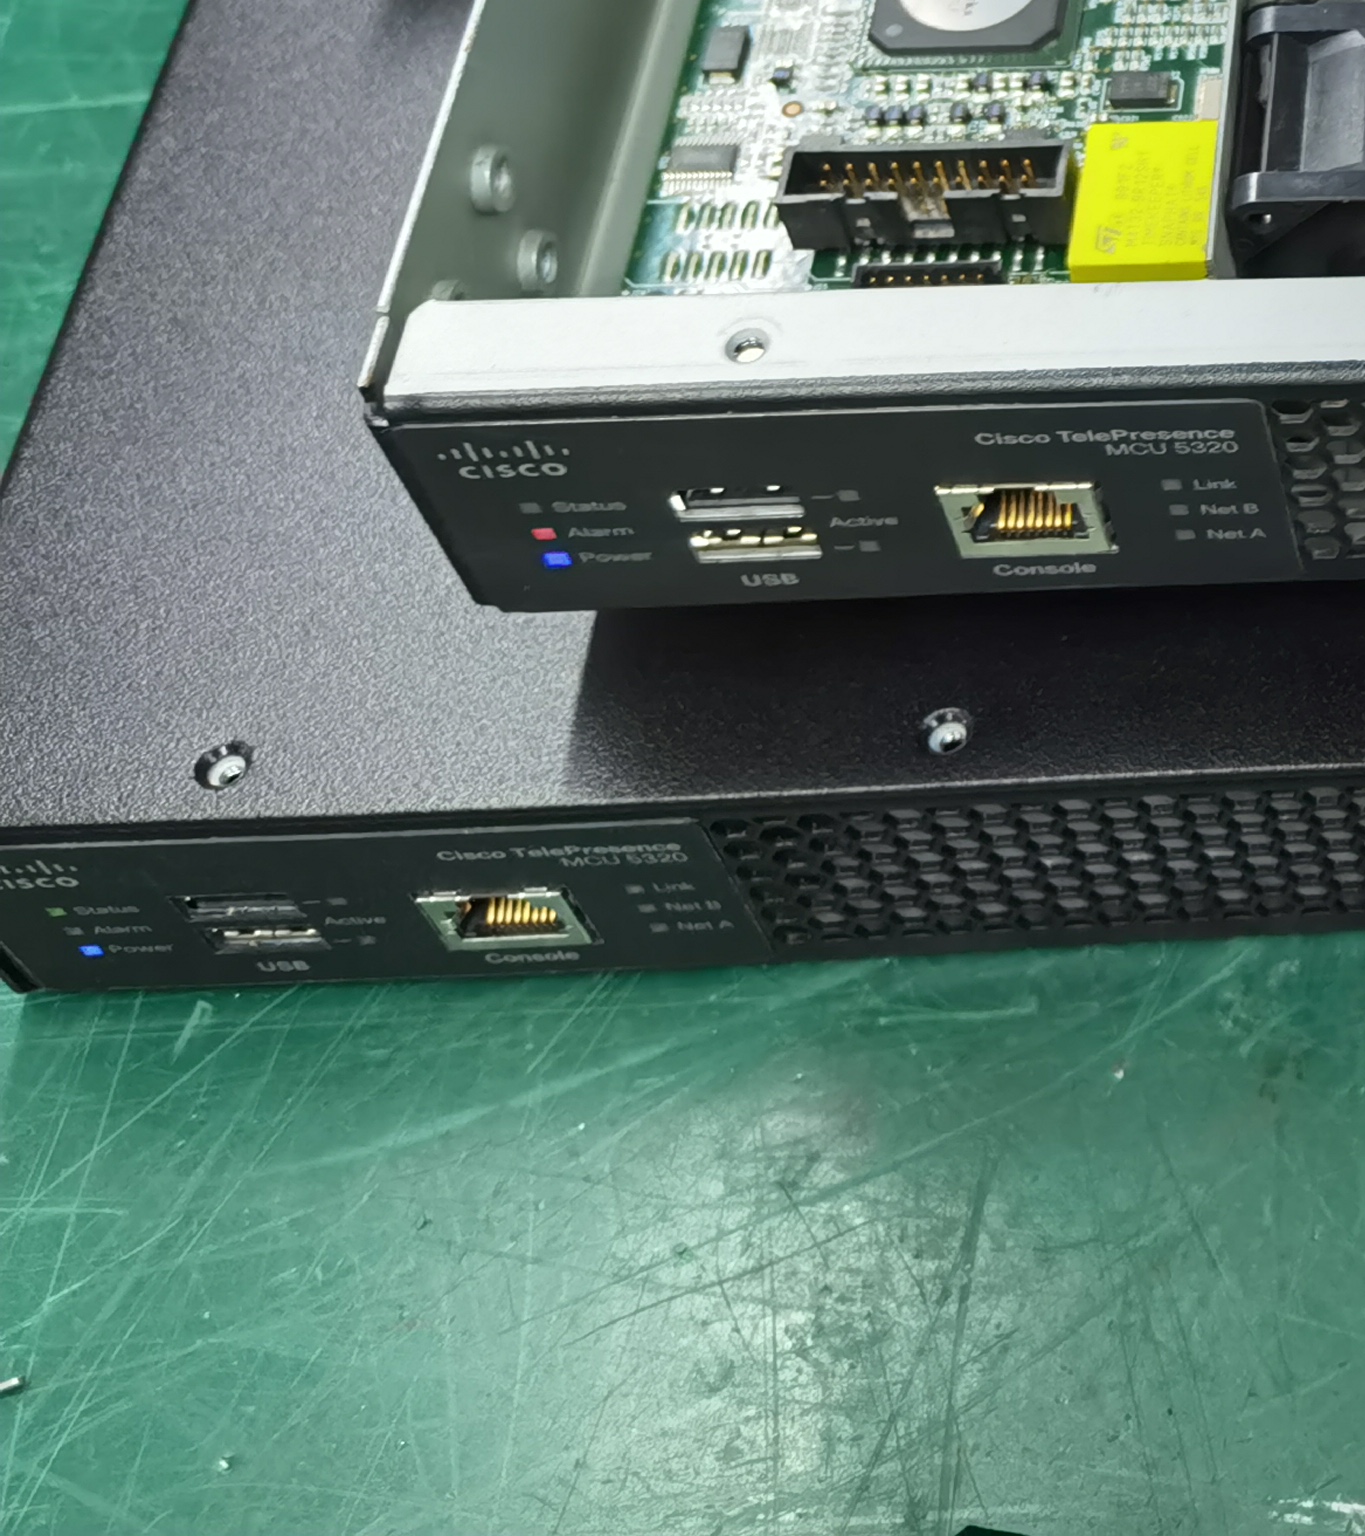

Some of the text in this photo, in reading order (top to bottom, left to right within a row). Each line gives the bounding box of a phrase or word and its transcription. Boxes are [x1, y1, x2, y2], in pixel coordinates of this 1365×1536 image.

[975, 428, 1235, 446] Cisco TelePresence
[1105, 440, 1239, 455] MCU 5320
[1192, 478, 1238, 491] Link
[551, 501, 627, 513] Status
[1200, 504, 1238, 515] Net
[829, 514, 899, 529] Active
[568, 524, 635, 538] Alarm
[1206, 528, 1244, 540] Net
[578, 550, 652, 563] Power
[993, 562, 1097, 577] Console
[740, 573, 800, 587] USB
[436, 841, 682, 862] Cisco TelePresence
[559, 852, 688, 867] MCU 5320
[0, 877, 79, 890] ISCO
[651, 881, 696, 893] Link
[72, 904, 140, 916] Status
[665, 901, 701, 911] Net
[324, 914, 387, 926] Active
[676, 920, 713, 932] Net
[94, 923, 152, 936] Alarm
[108, 943, 174, 955] Power
[485, 949, 580, 965] Console
[256, 958, 311, 973] USB
